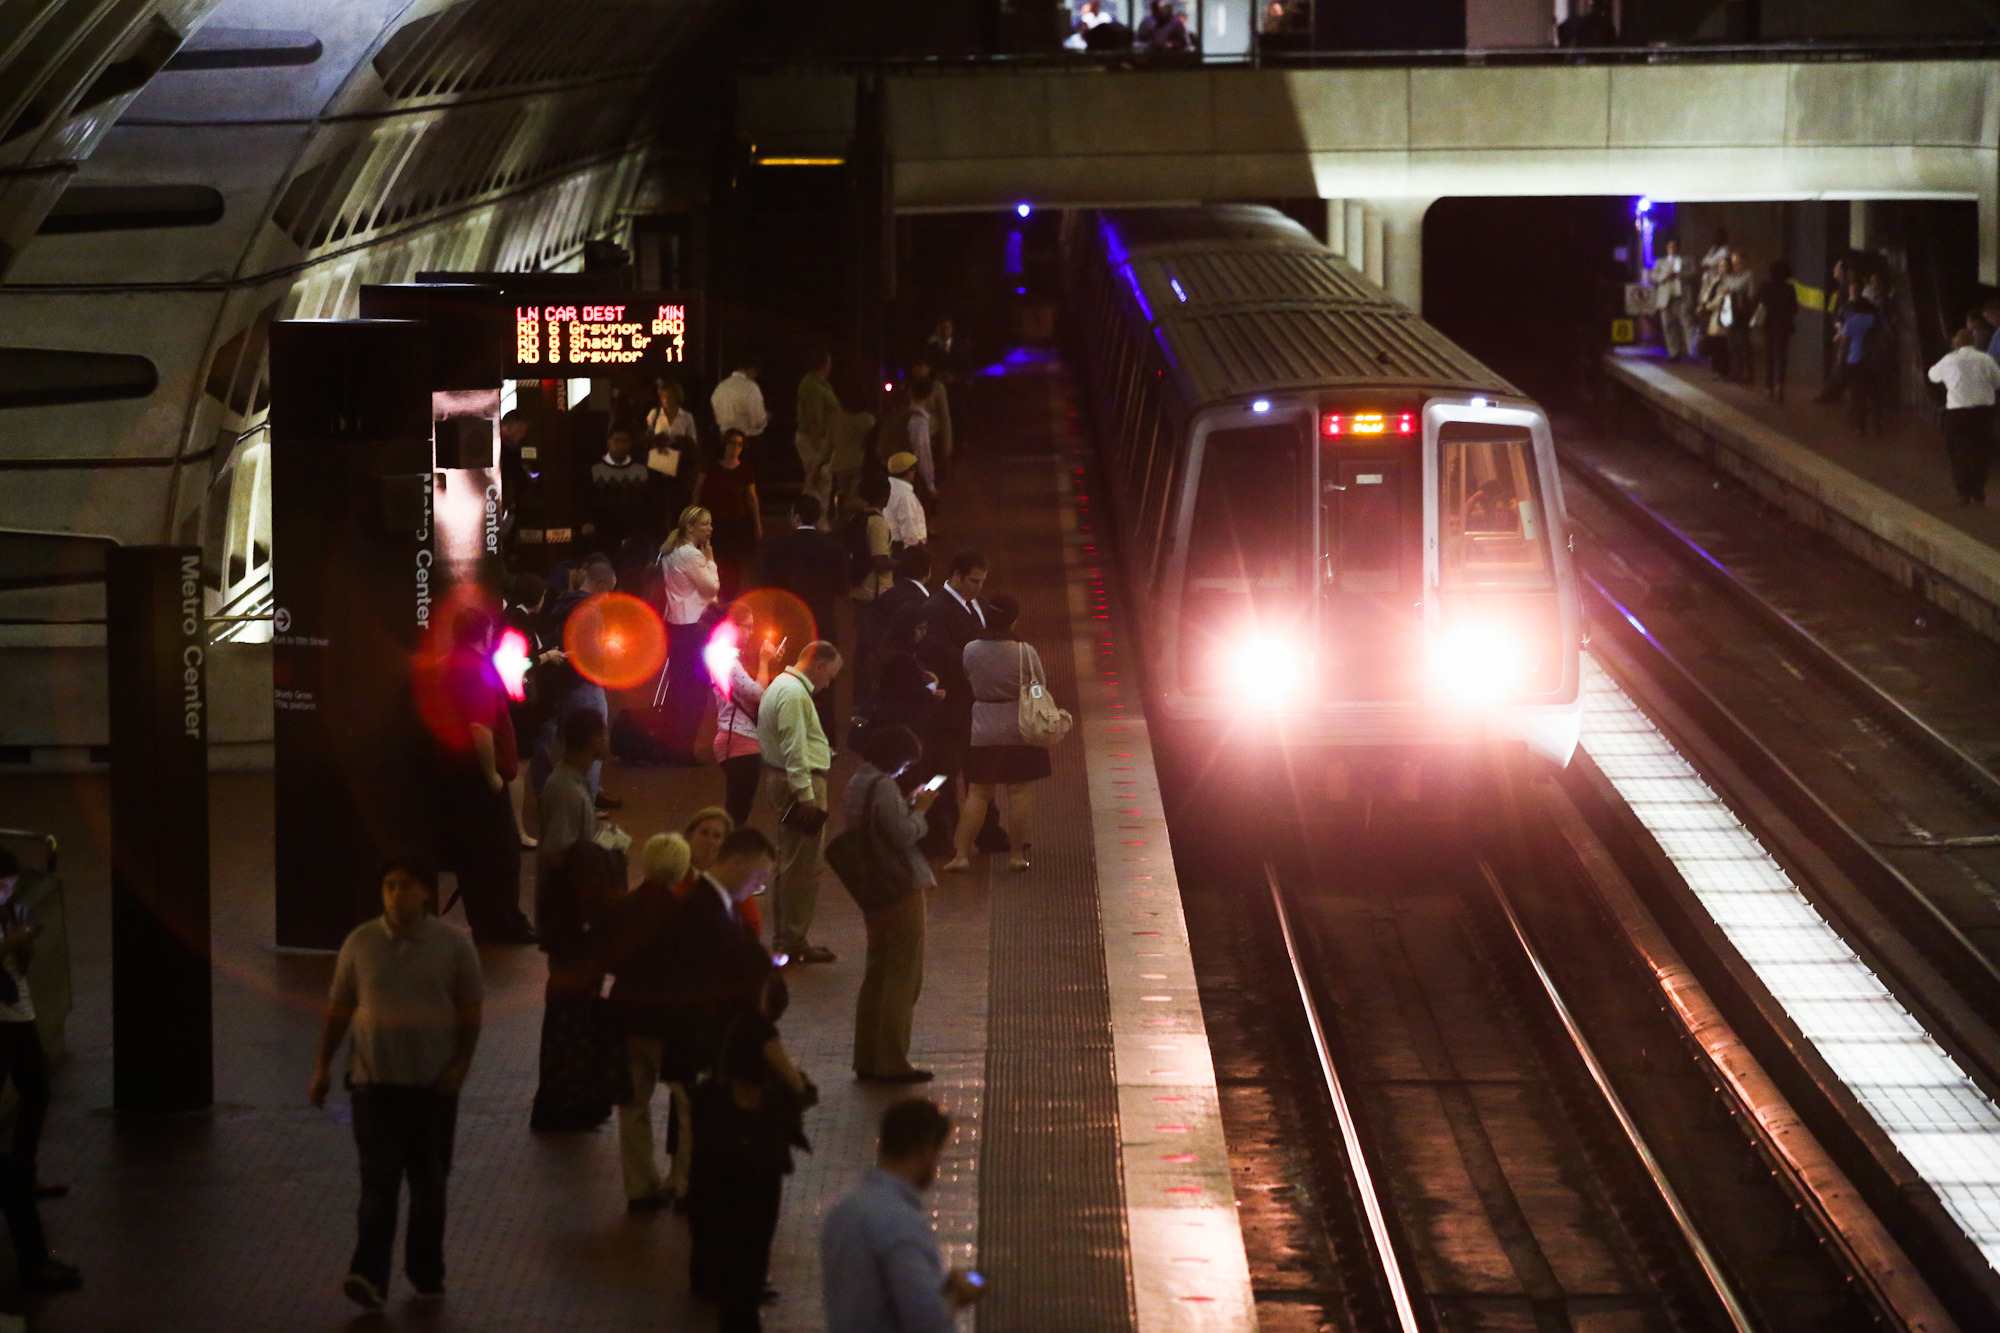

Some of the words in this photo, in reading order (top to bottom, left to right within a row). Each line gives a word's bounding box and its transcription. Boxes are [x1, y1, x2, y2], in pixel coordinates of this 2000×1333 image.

[517, 307, 539, 321] LN
[545, 306, 577, 321] CAR
[583, 306, 625, 321] DEST
[658, 306, 684, 320] MIN
[517, 322, 539, 335] RD
[548, 322, 560, 335] 6
[569, 321, 642, 335] Grsvnor
[652, 319, 684, 334] BRD
[517, 336, 539, 349] RD
[549, 336, 560, 349] 8
[569, 336, 623, 350] Shady
[632, 335, 652, 349] Gr
[673, 334, 684, 348] 4
[517, 349, 539, 363] RD
[549, 349, 560, 363] 6
[569, 349, 643, 363] Grsvnor
[665, 347, 683, 363] 11
[485, 484, 501, 554] Center
[181, 555, 200, 636] Metro
[416, 549, 432, 630] Center
[183, 645, 203, 739] Center
